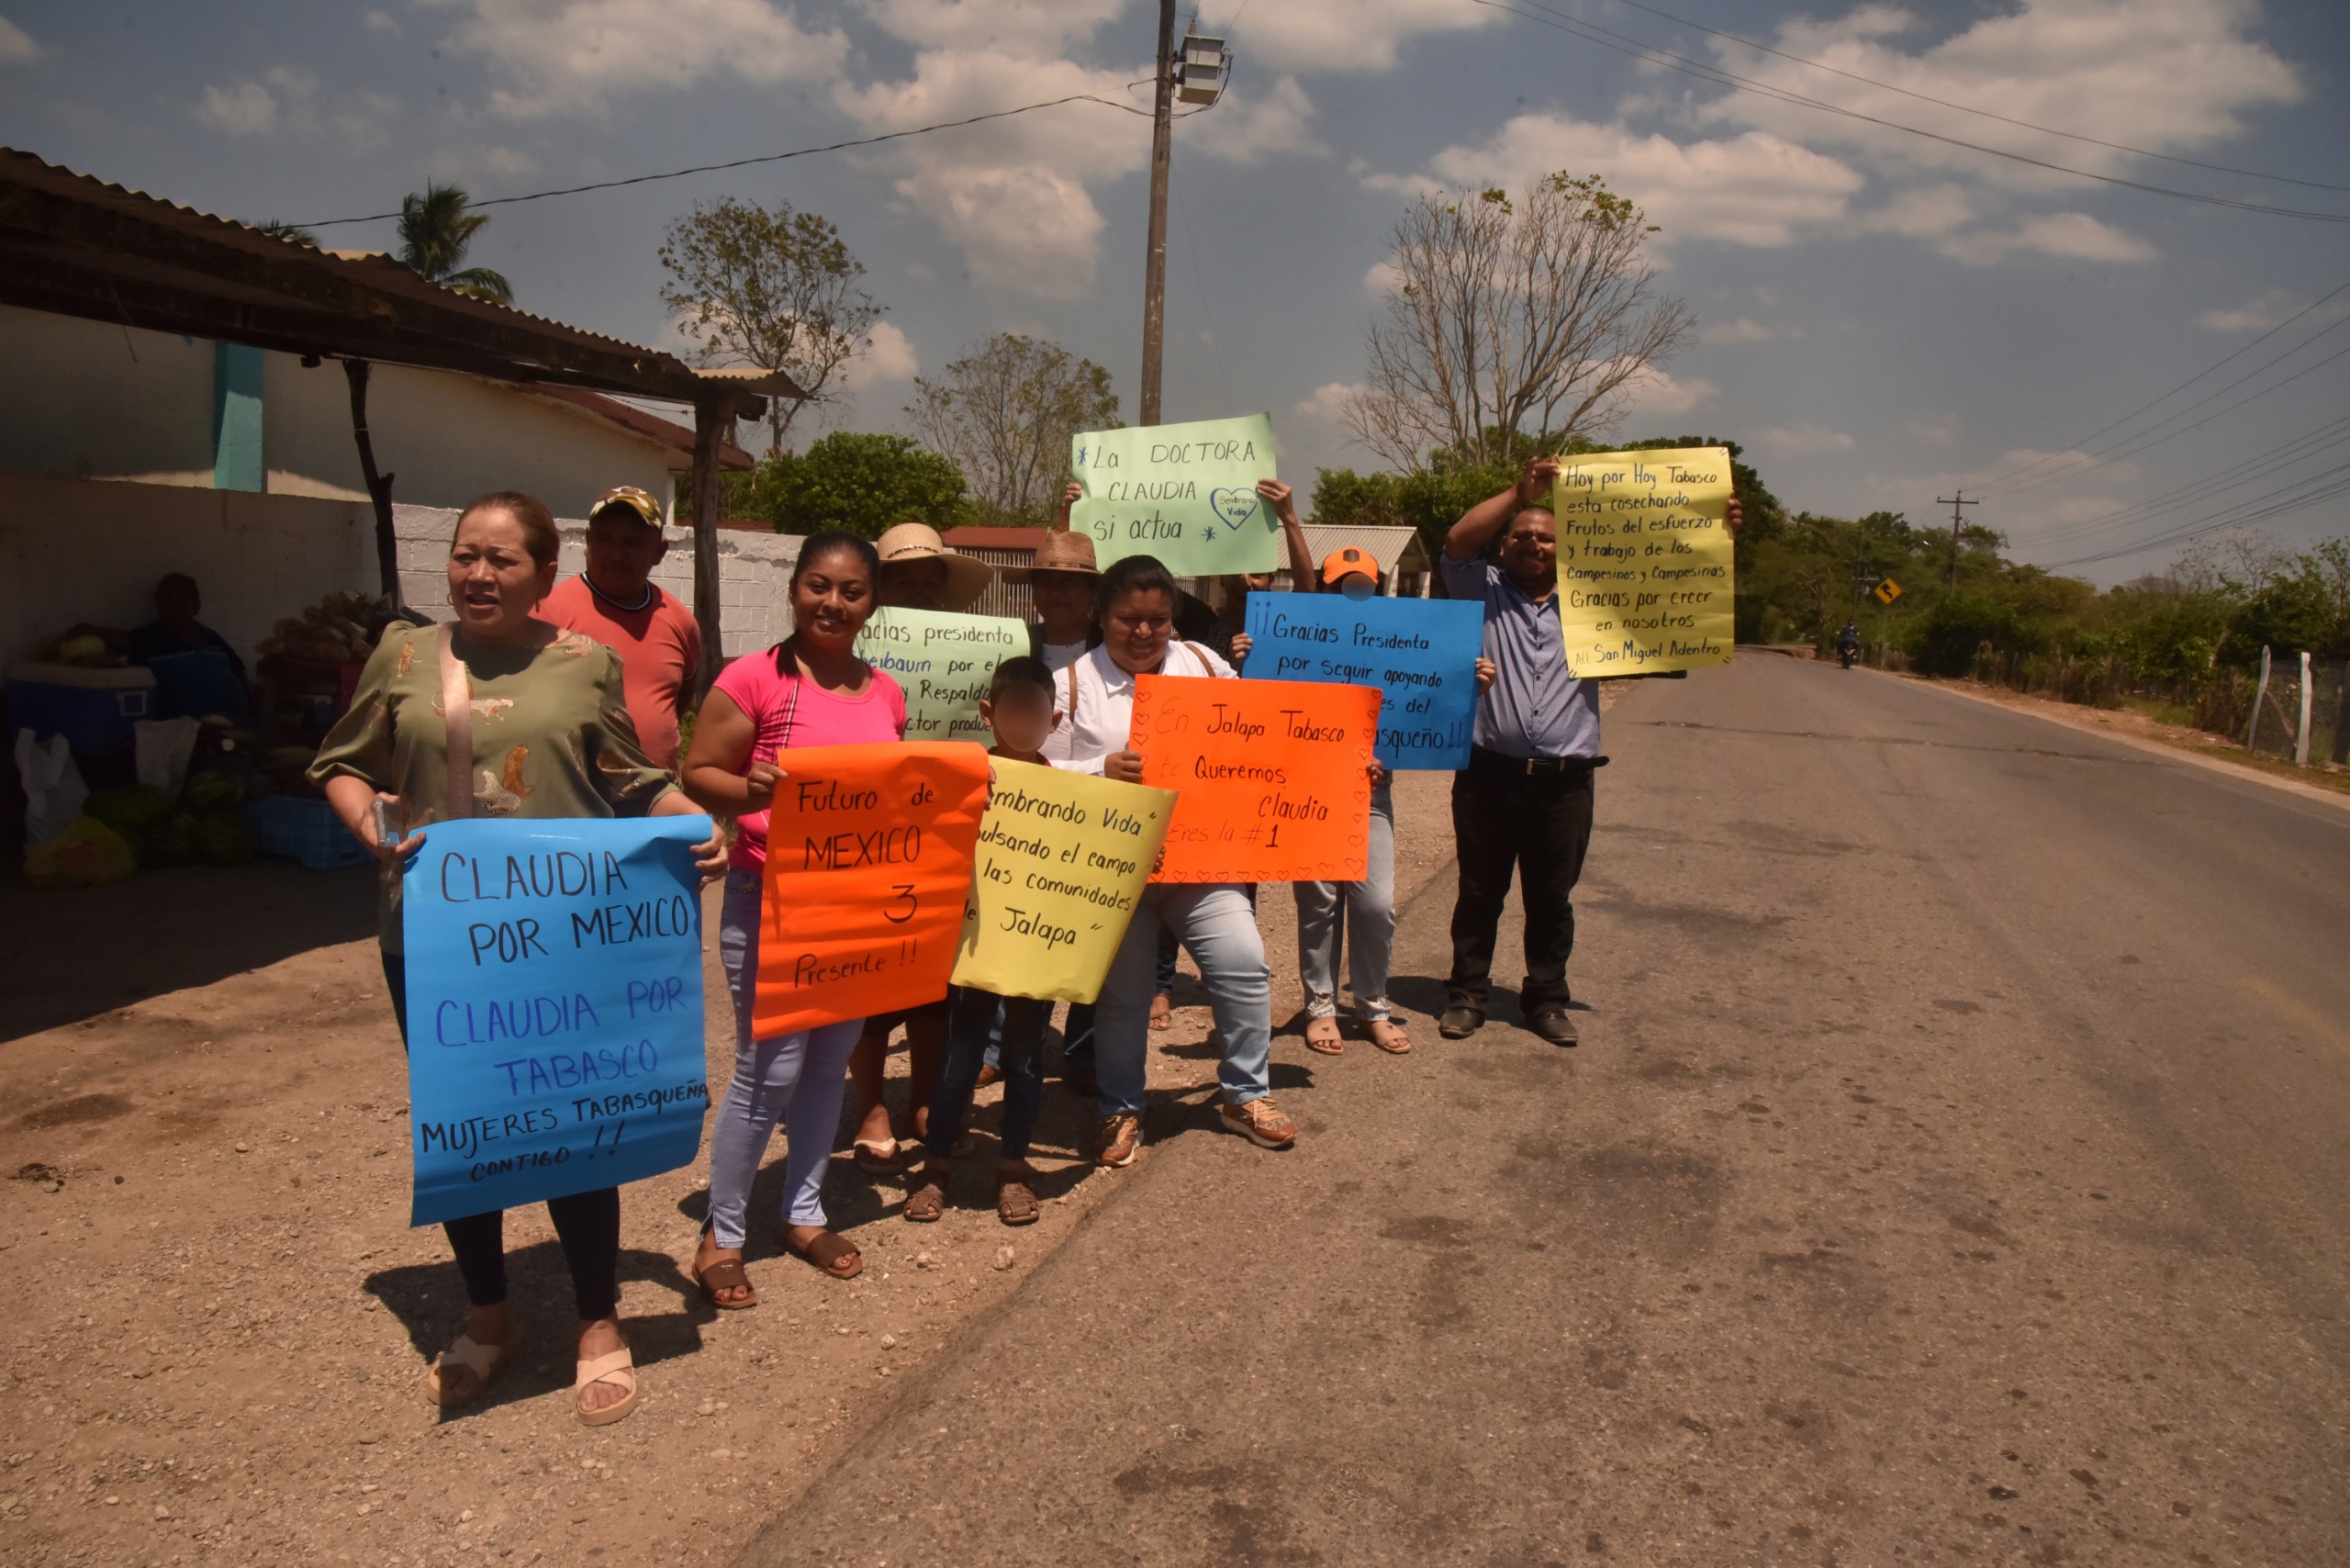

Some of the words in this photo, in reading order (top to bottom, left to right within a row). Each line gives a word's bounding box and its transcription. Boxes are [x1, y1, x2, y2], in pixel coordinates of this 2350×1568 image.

[1093, 445, 1119, 468] La
[1150, 441, 1256, 464] DOCTORA
[1109, 481, 1196, 501] CLAUDIA
[1565, 465, 1594, 493] Hoy
[1602, 471, 1626, 491] por
[1634, 463, 1656, 489] Hoy
[1666, 465, 1718, 484] Tabasco
[1227, 507, 1247, 516] Vida
[1567, 497, 1601, 514] esta
[1611, 490, 1690, 511] cosechando
[1093, 515, 1115, 541] si
[1129, 510, 1182, 540] actua
[1567, 519, 1615, 535] Frutos
[1623, 517, 1641, 533] del
[1649, 516, 1712, 532] esfuerzo
[1568, 544, 1574, 559] y
[1584, 540, 1636, 563] trabajo
[1644, 543, 1663, 555] de
[1671, 539, 1692, 554] los
[1567, 566, 1636, 582] Campesinos
[1640, 571, 1646, 582] y
[1651, 566, 1726, 581] Campesinas
[1571, 589, 1629, 608] Gracias
[1636, 593, 1661, 611] por
[1670, 591, 1713, 604] creer
[862, 622, 911, 643] acias
[924, 626, 1013, 647] presidenta
[1353, 622, 1429, 650] Presidenta
[1595, 621, 1612, 632] en
[1622, 611, 1695, 629] nosotros
[947, 662, 974, 676] por
[984, 654, 1002, 671] el
[1595, 644, 1619, 663] San
[1622, 640, 1662, 665] Miguel
[1669, 638, 1720, 656] Adentro
[1277, 655, 1311, 676] por
[1384, 668, 1443, 689] apoyando
[905, 709, 941, 731] ctor
[1155, 697, 1190, 734] En
[1207, 703, 1265, 743] Jalapa
[1280, 710, 1345, 743] Tabasco
[1381, 699, 1394, 710] es
[1405, 698, 1431, 713] del
[1160, 755, 1180, 778] te
[1195, 755, 1287, 784] Queremos
[797, 780, 878, 812] Futuro
[911, 782, 934, 807] de
[994, 789, 1086, 824] mbrando
[1165, 823, 1209, 843] Eres
[1218, 819, 1235, 842] la
[803, 825, 921, 870] MEXICO
[1060, 843, 1080, 864] el
[1088, 851, 1136, 877] campo
[441, 850, 629, 902] CLAUDIA
[983, 857, 1013, 885] las
[1025, 873, 1132, 912] comunidades
[884, 884, 918, 924] 3
[468, 918, 549, 967] POR
[570, 895, 688, 949] MEXICO
[1000, 906, 1077, 950] Jalapa
[794, 954, 886, 989] Presente
[436, 992, 600, 1047] CLAUDIA
[626, 976, 688, 1020] POR
[495, 1039, 659, 1096] TABASCO
[420, 1108, 558, 1159] MUJERES
[470, 1146, 571, 1182] CONTIGO
